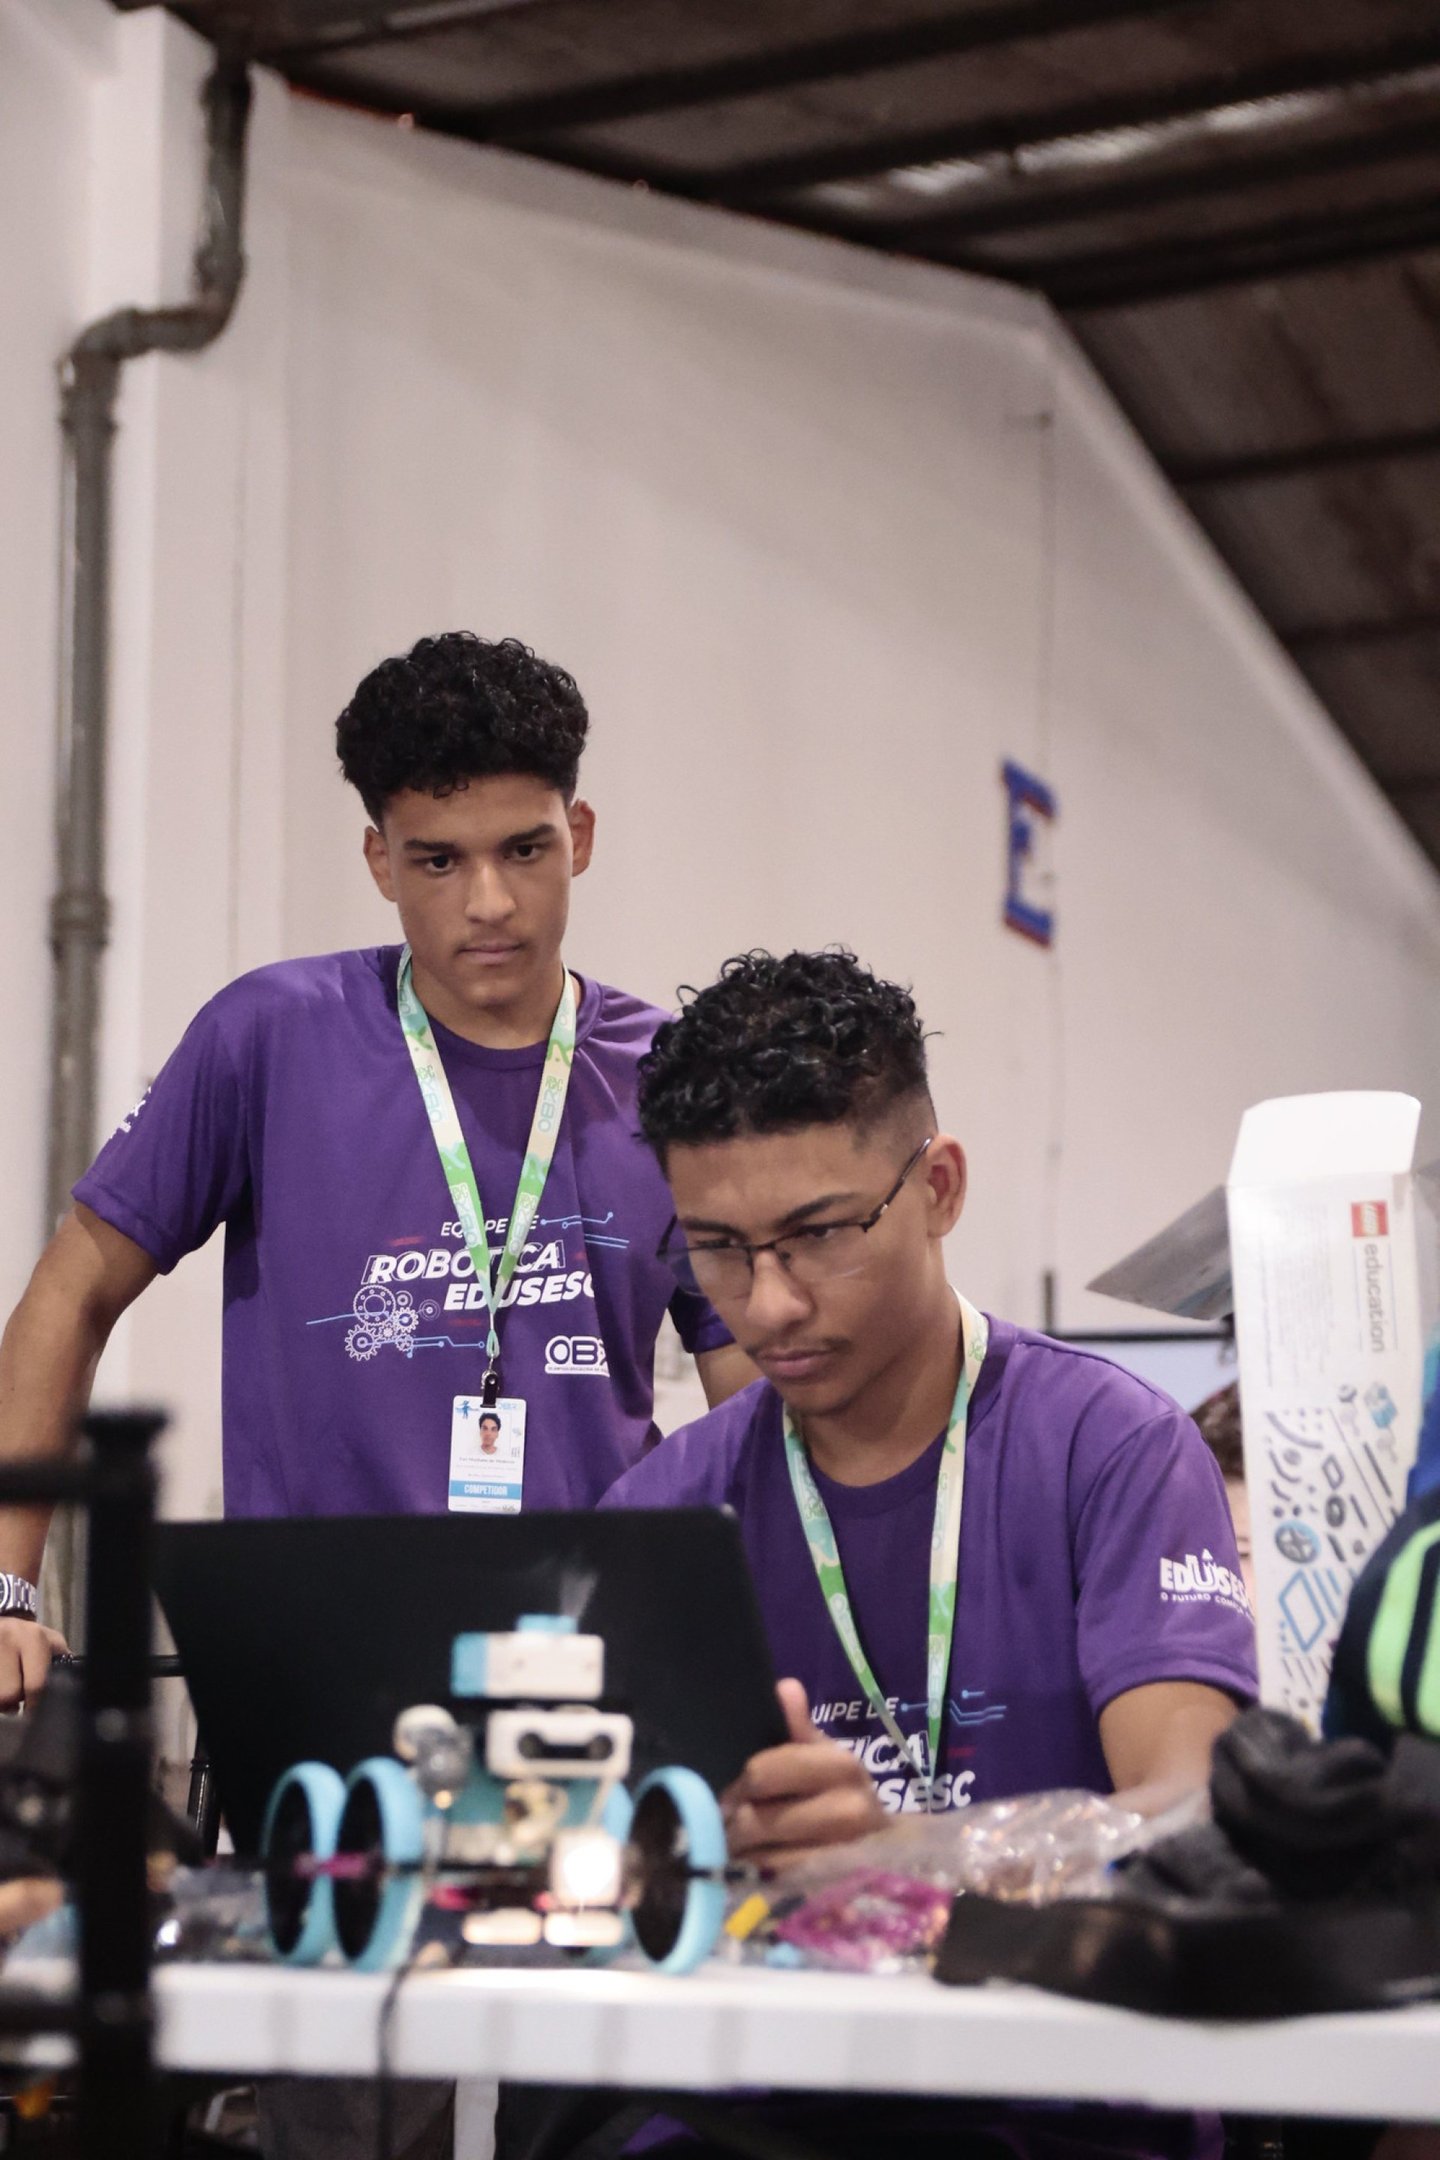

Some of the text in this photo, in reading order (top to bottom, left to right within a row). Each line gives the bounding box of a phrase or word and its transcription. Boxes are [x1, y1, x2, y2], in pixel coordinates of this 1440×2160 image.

[441, 1217, 508, 1238] EQPE
[1364, 1243, 1387, 1354] education
[1172, 1593, 1212, 1603] FUTURO
